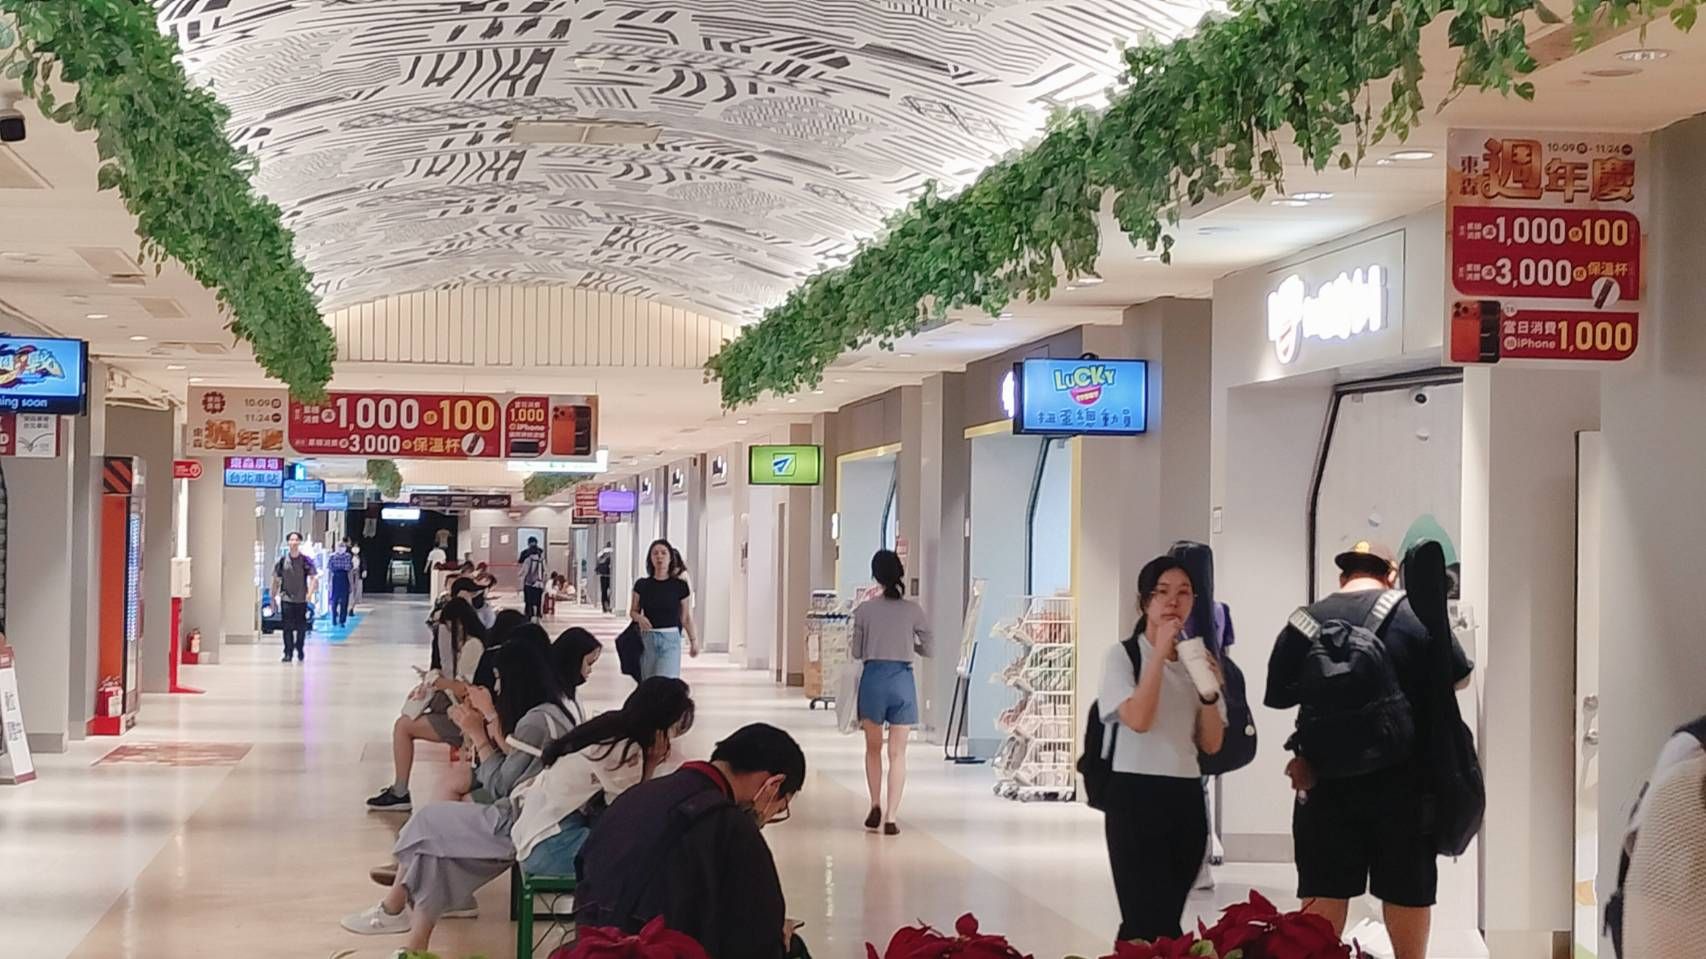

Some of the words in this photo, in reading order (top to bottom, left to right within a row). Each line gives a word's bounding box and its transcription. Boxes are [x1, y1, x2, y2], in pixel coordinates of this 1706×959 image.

[1480, 137, 1636, 204] 週年慶
[1496, 216, 1566, 247] 1,000
[1582, 218, 1629, 247] 100
[1495, 257, 1572, 288] 3,000
[1503, 320, 1556, 334] 當日消費
[1517, 337, 1556, 349] iPhone
[1557, 321, 1633, 353] 1,000
[22, 399, 48, 407] soon
[336, 397, 419, 431] 1,000
[439, 399, 495, 431] 100
[510, 408, 545, 422] 1,000
[349, 434, 400, 454] 3,000
